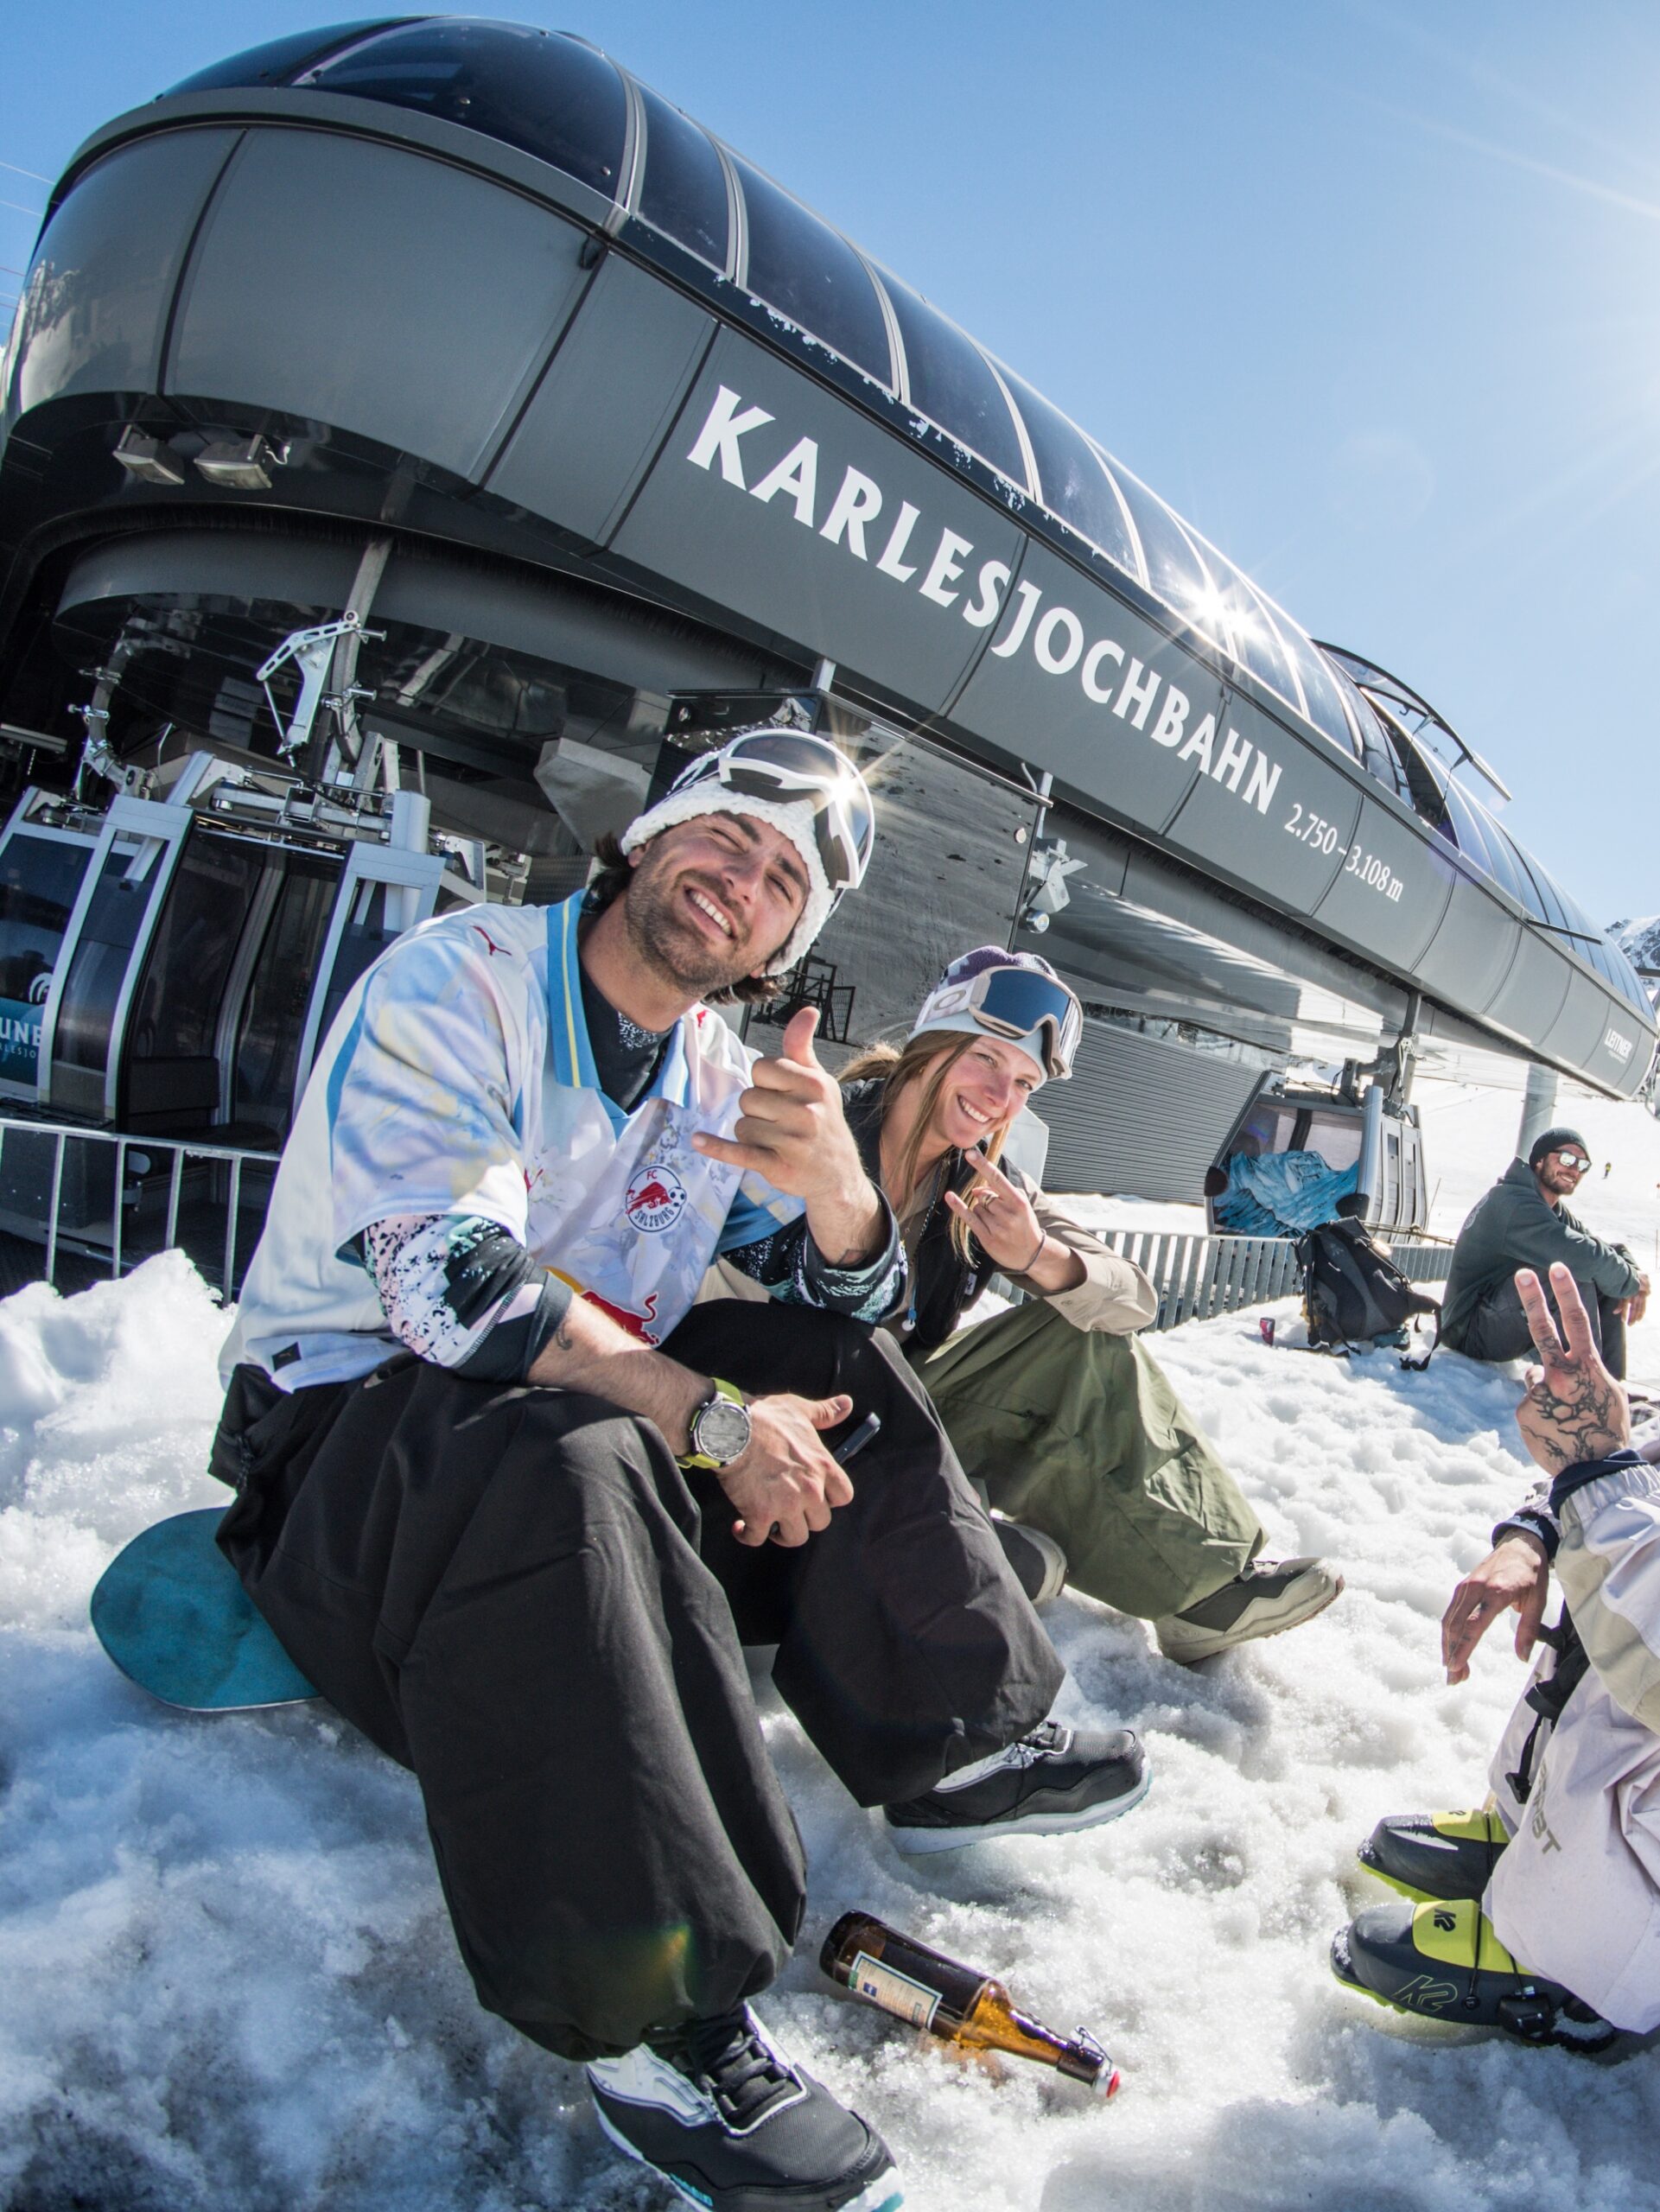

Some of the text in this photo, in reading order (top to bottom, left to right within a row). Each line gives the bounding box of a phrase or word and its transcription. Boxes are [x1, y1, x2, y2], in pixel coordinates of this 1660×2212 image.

[688, 385, 1282, 815] KARLESJOCHBAHN
[646, 1169, 658, 1180] FC
[634, 1207, 675, 1227] SALZBURG
[1434, 1908, 1456, 1932] K2
[1392, 1974, 1458, 2012] K2
